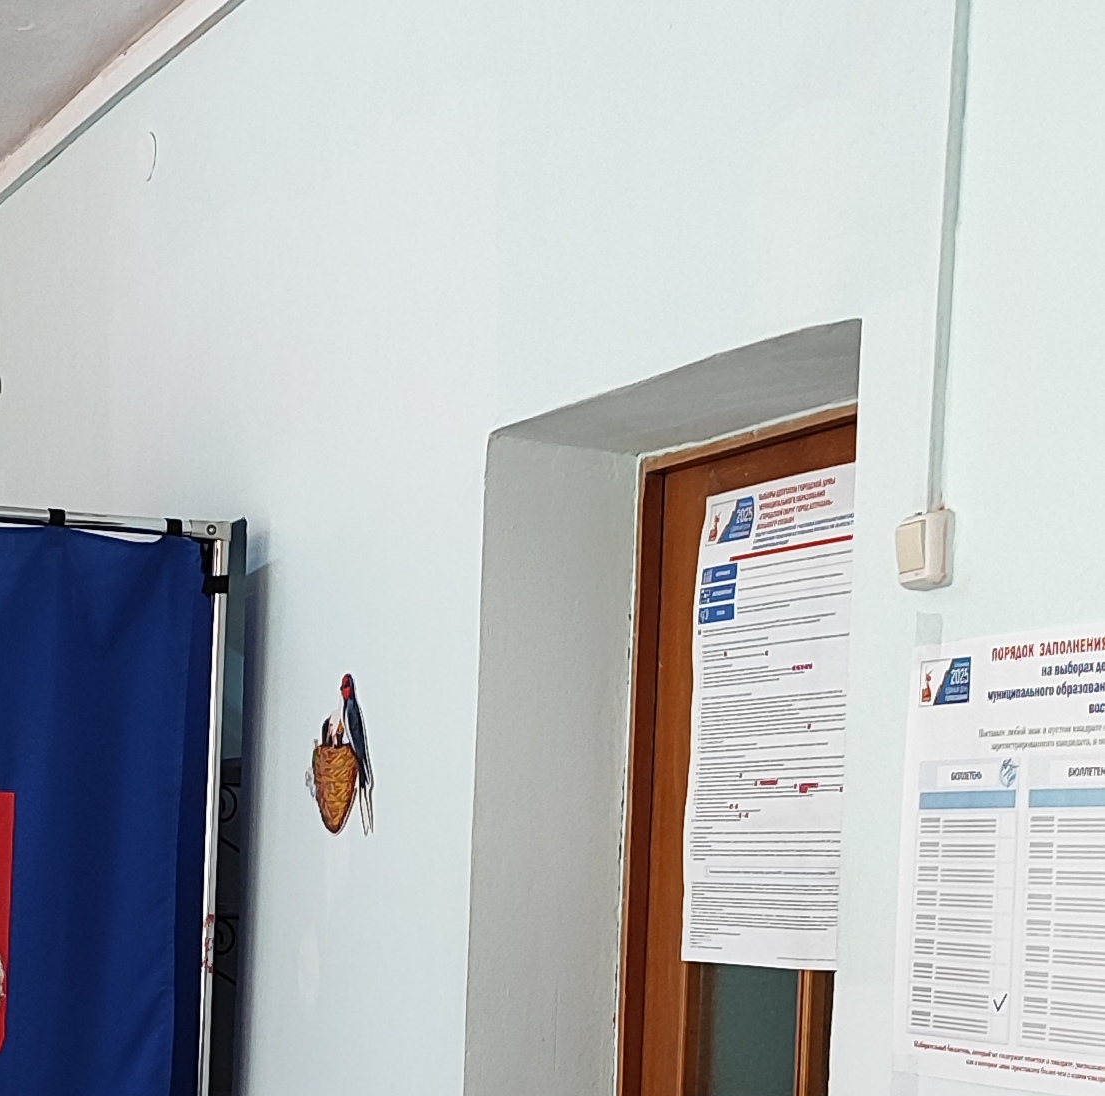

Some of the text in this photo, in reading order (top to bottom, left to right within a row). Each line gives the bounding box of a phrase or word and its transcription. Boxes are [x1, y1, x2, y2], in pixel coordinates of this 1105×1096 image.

[991, 644, 1034, 661] ПОРЯДОК
[950, 668, 969, 685] 2025
[1041, 665, 1052, 677] на
[1054, 660, 1094, 678] выборах
[987, 685, 1054, 704] муниципального
